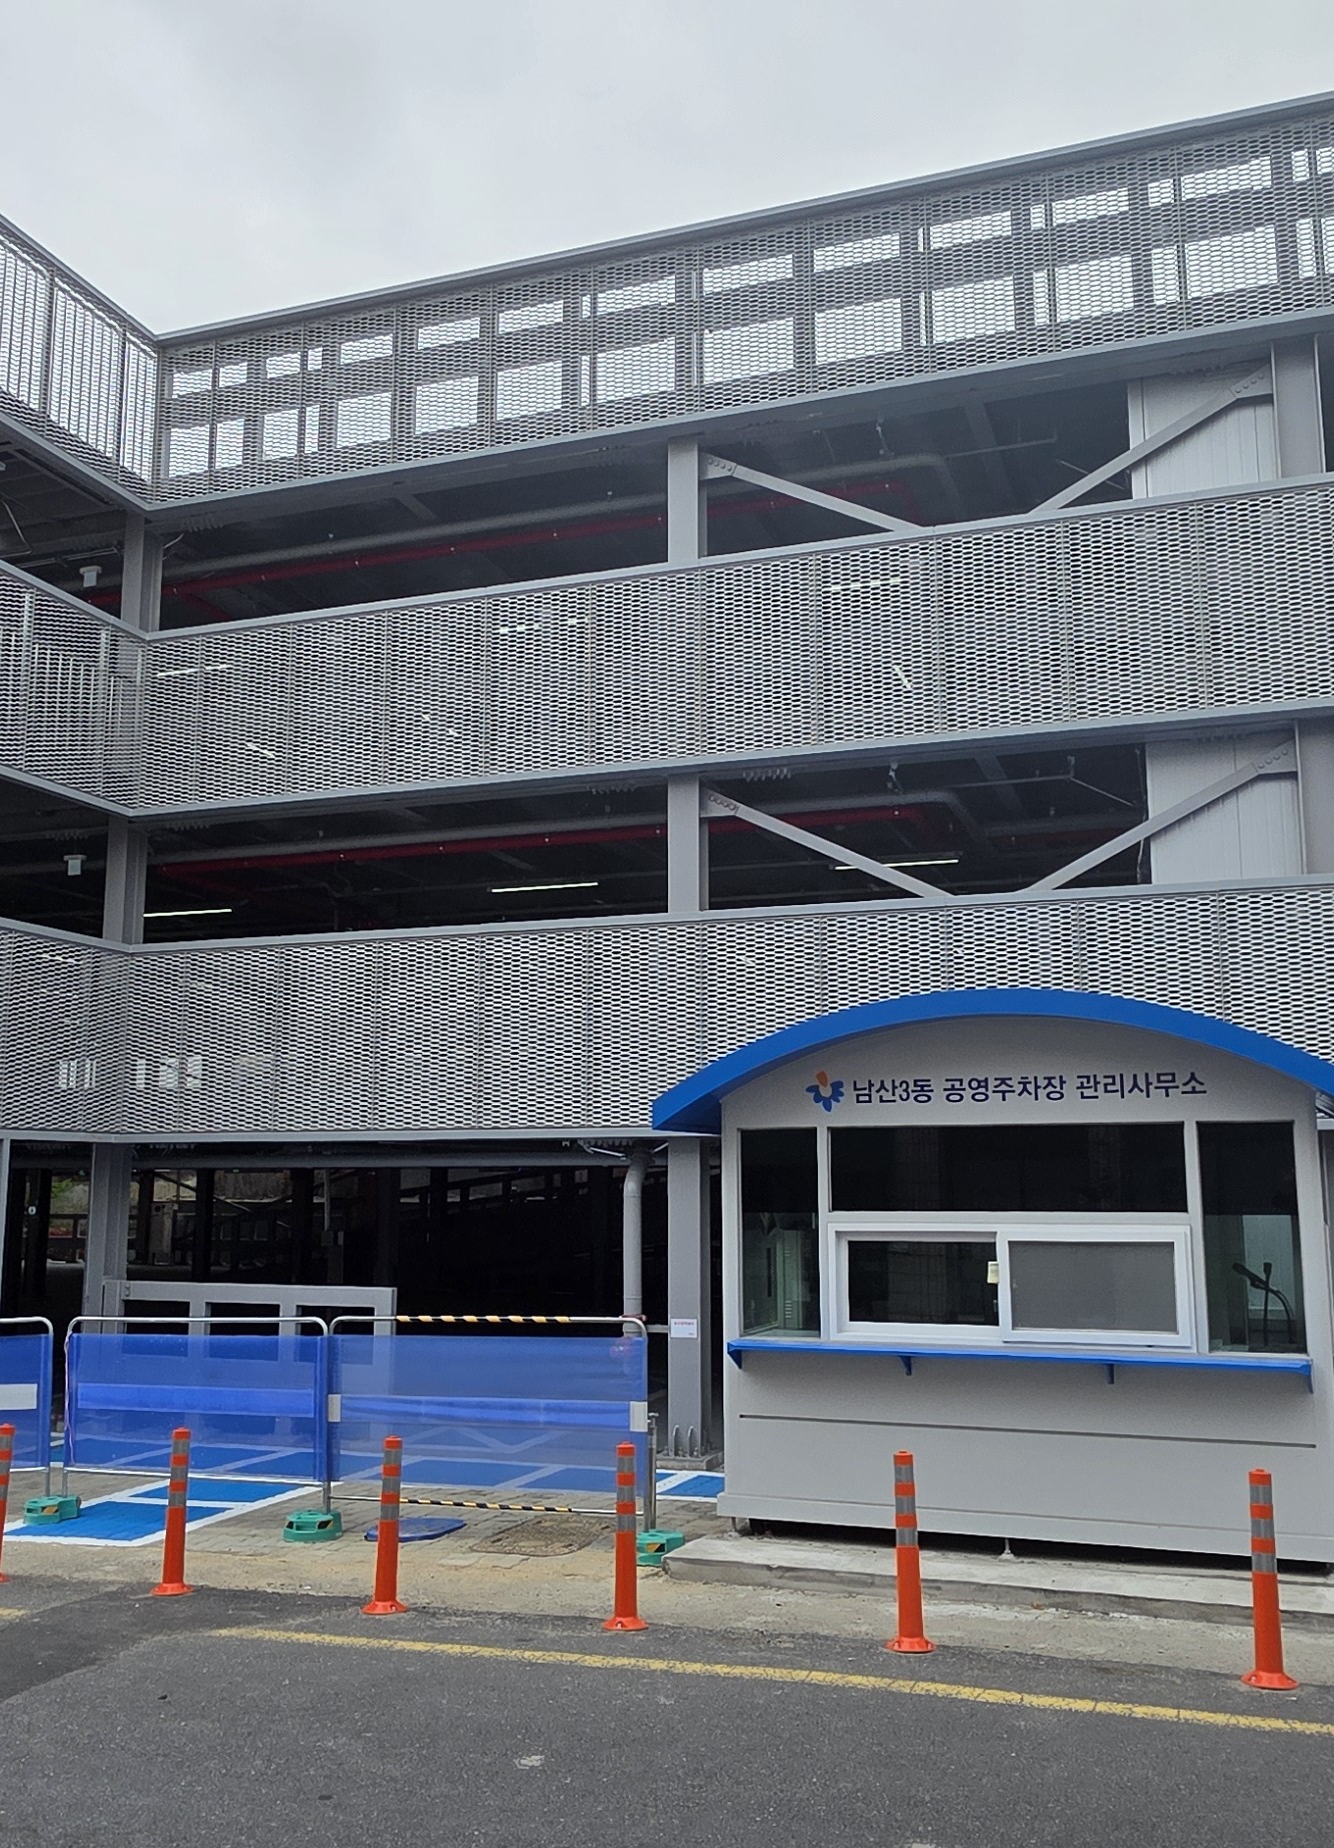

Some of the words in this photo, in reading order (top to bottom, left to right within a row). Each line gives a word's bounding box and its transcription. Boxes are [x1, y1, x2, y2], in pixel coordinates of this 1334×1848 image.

[852, 1077, 936, 1105] 남산3동
[942, 1074, 1068, 1104] 공영주차장
[1075, 1071, 1209, 1101] 관리사무소
